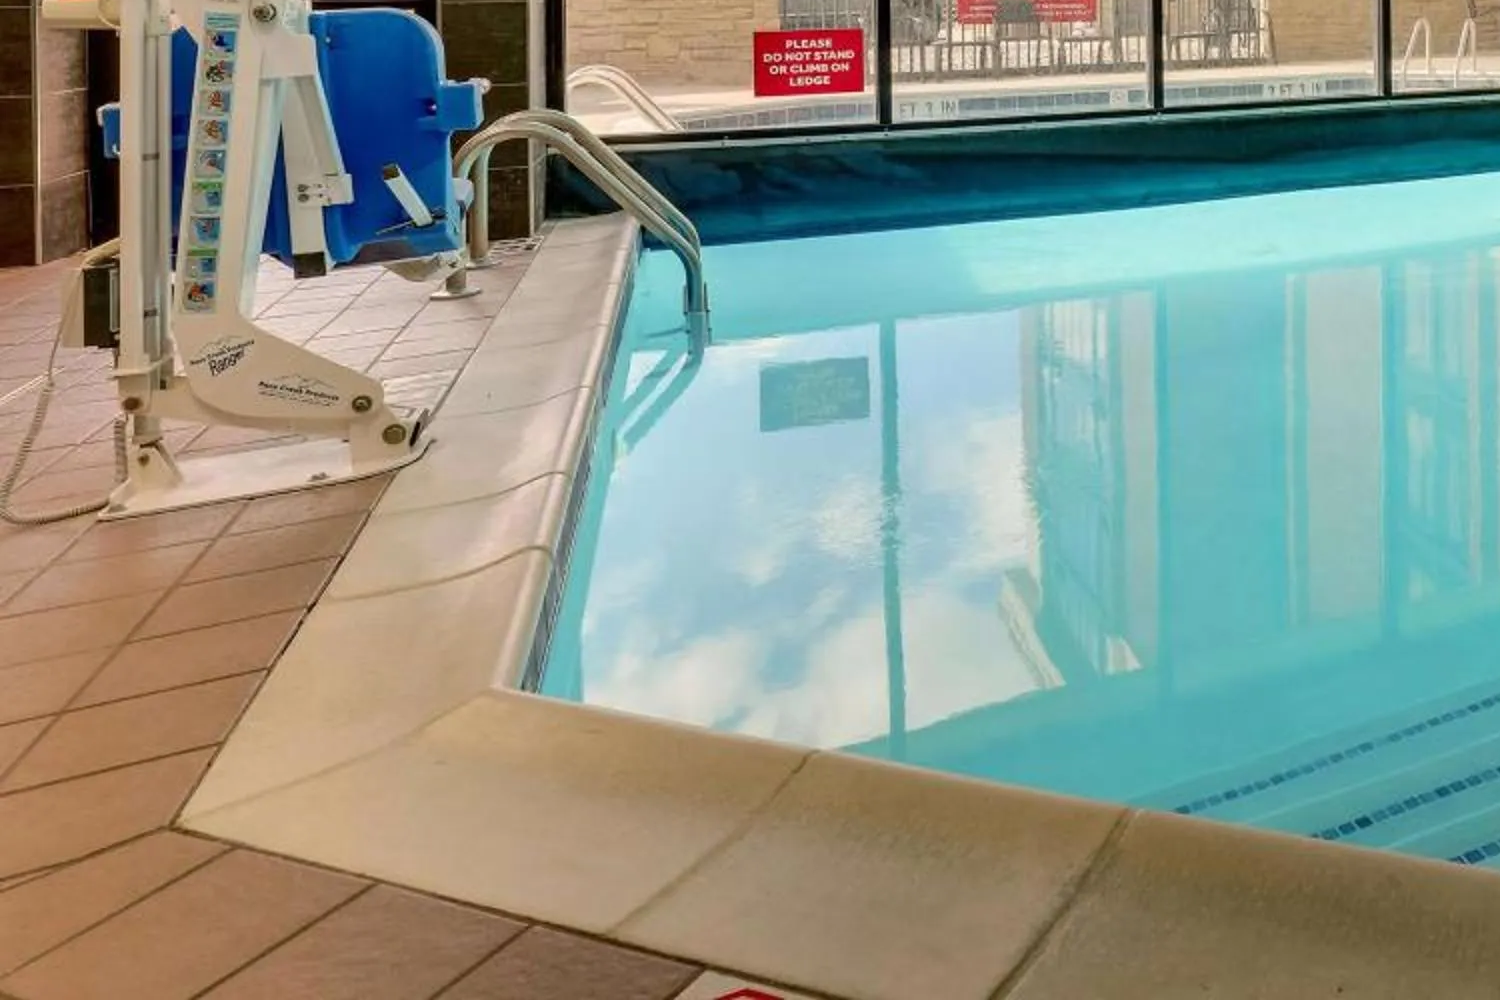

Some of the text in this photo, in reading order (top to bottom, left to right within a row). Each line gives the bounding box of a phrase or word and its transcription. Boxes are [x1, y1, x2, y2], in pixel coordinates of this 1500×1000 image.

[785, 38, 833, 49] PLEASE
[762, 49, 856, 63] DO NOT STAND
[769, 61, 850, 75] OR CLIMB ON
[789, 75, 831, 87] LEDGE
